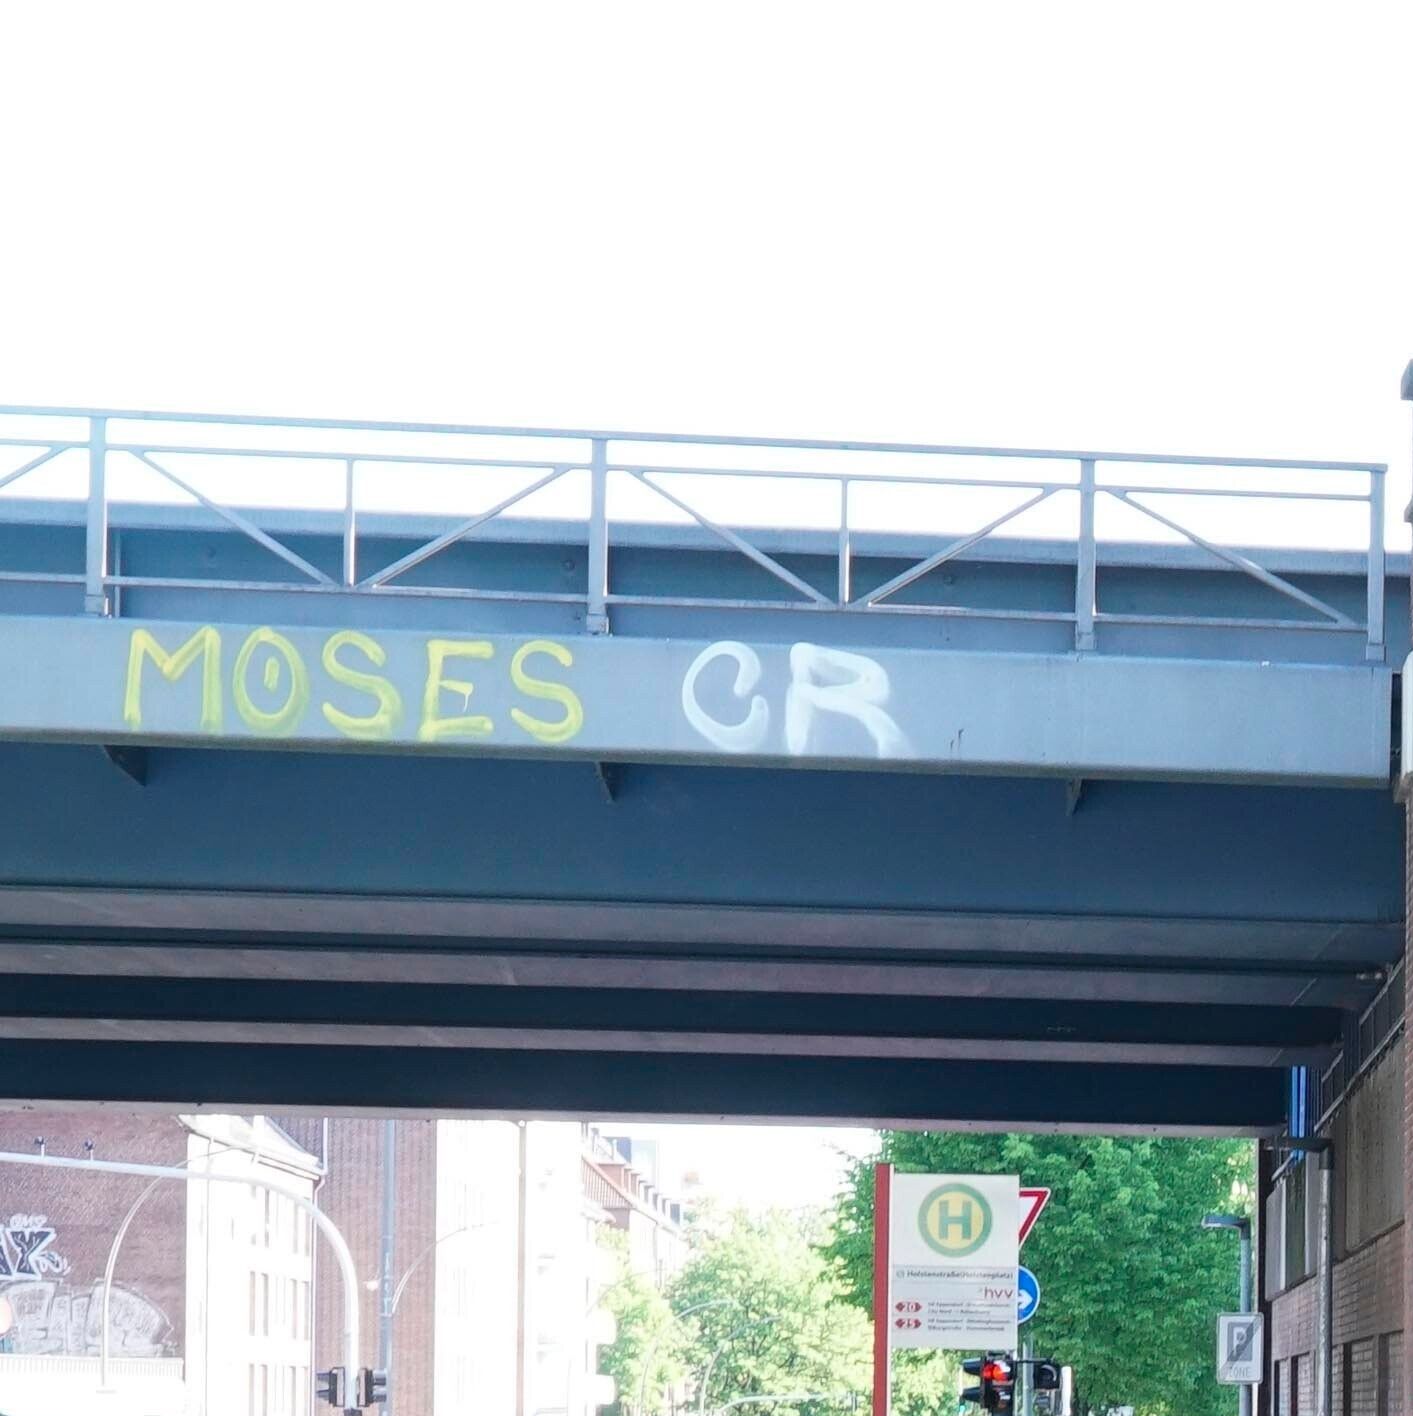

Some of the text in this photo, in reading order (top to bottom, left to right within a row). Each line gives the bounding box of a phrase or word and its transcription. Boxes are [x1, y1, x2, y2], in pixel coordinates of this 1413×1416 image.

[124, 624, 585, 743] MOSES
[940, 1201, 972, 1240] H
[985, 1286, 1014, 1299] hvv
[1229, 1367, 1250, 1377] ZONE
